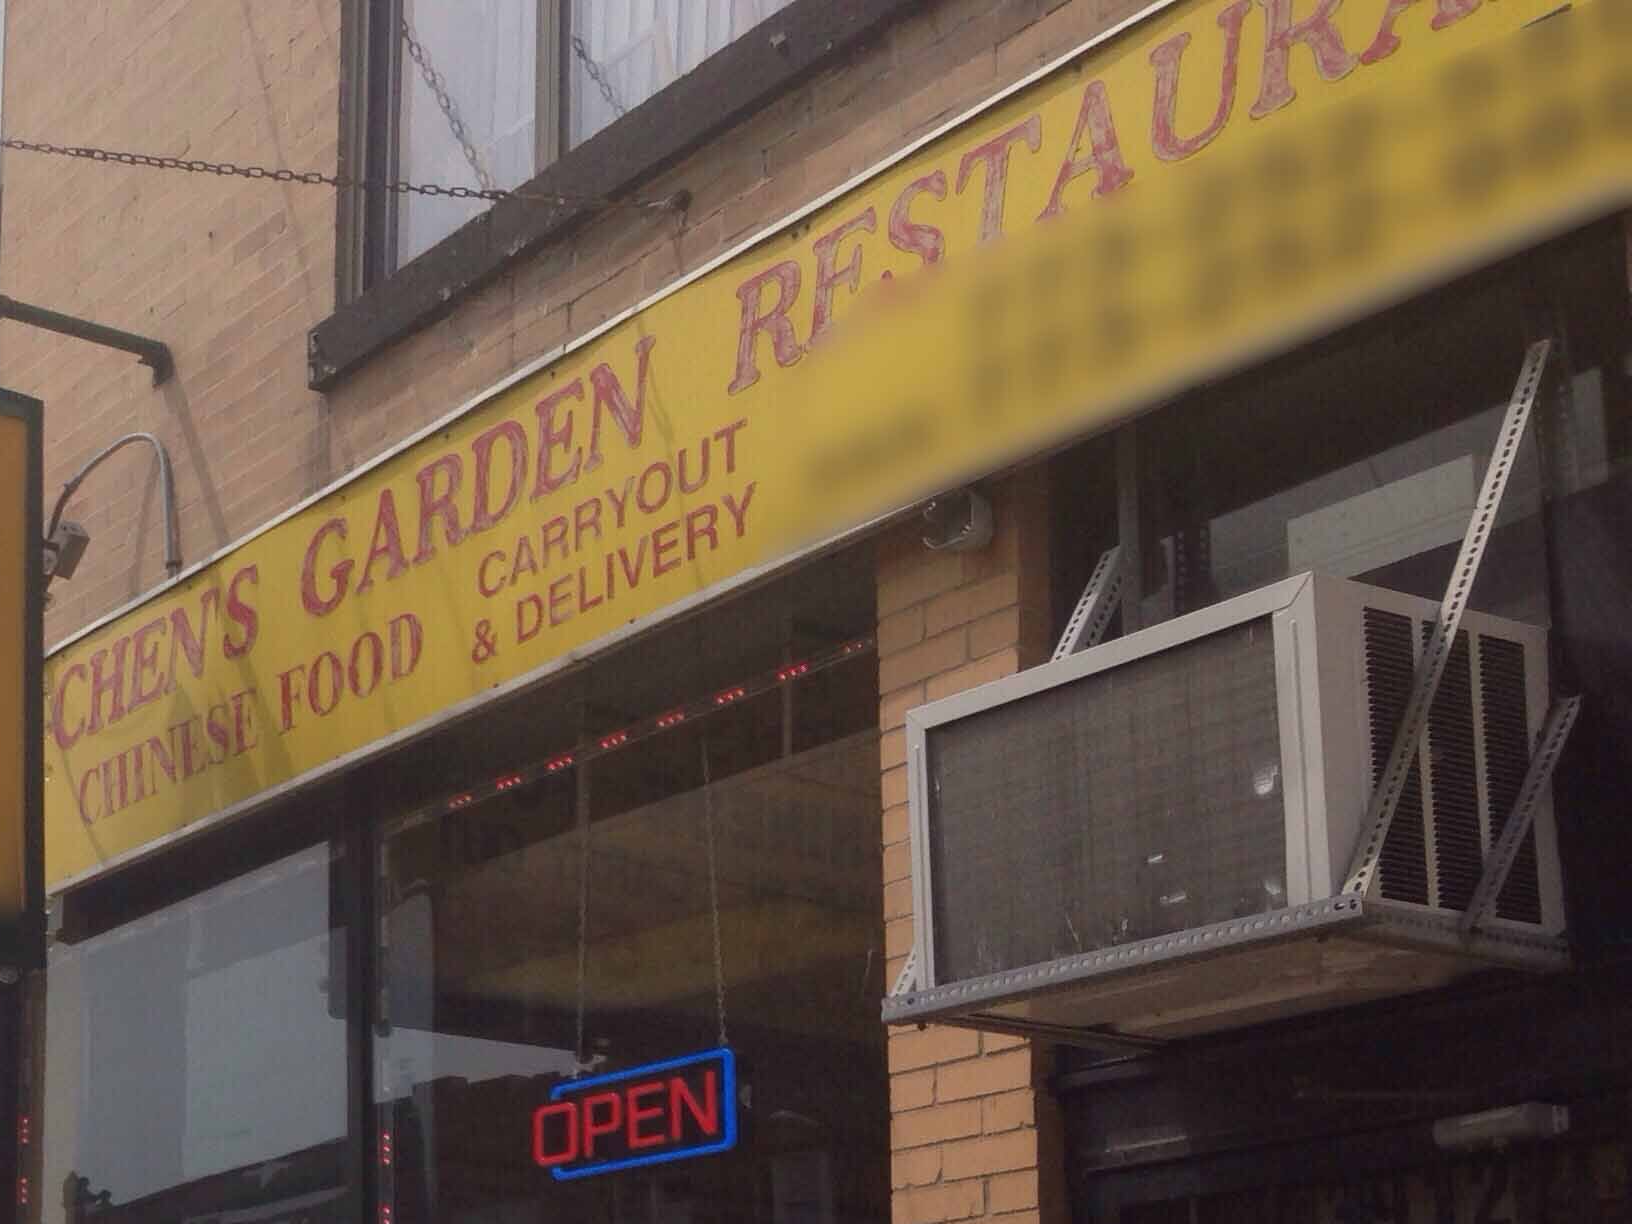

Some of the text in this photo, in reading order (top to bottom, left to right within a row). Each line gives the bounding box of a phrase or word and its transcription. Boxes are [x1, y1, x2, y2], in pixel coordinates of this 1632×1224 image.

[53, 564, 259, 752] CHEN'S
[299, 340, 649, 617] GARDEN
[471, 482, 757, 665] & DELIVERY
[477, 418, 748, 600] CARRYOUT
[78, 683, 259, 826] CHINESE
[275, 611, 424, 732] FOOD
[531, 1069, 718, 1167] OPEN
